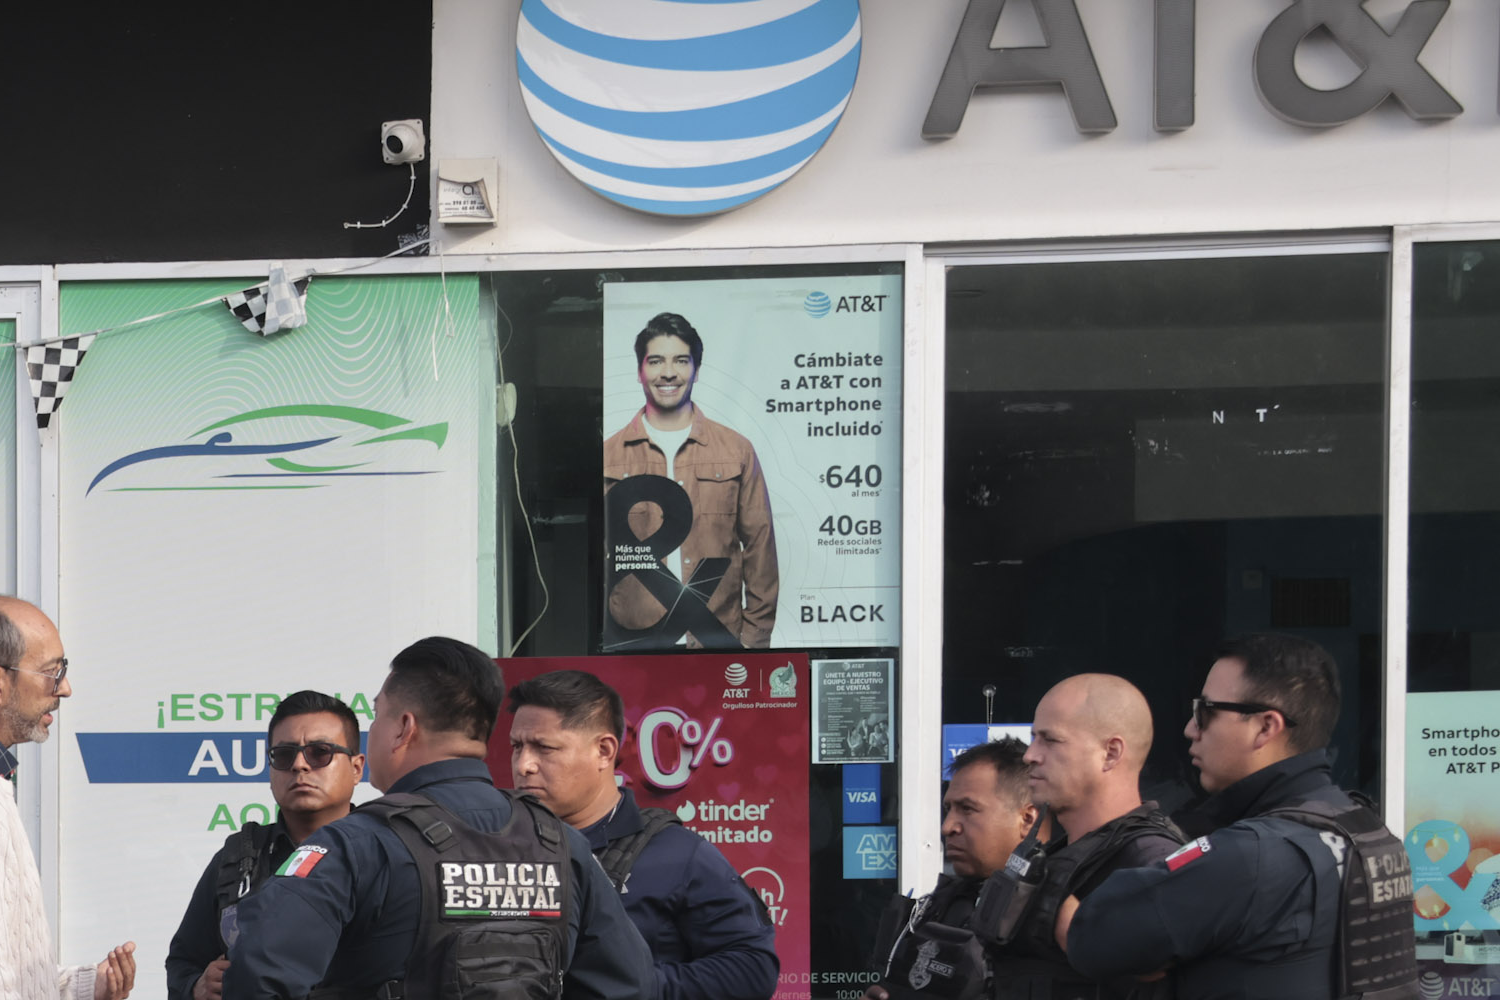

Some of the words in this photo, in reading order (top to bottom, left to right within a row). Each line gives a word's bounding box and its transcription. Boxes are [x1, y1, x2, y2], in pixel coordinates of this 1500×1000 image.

[835, 295, 887, 313] AT&T
[793, 352, 884, 369] Cámbiate
[780, 378, 791, 390] a
[795, 375, 844, 390] AT&T
[849, 376, 883, 389] con
[765, 398, 882, 415] Smartphone
[807, 422, 883, 437] incluido
[819, 464, 883, 489] $640
[851, 489, 860, 498] al
[615, 545, 633, 553] Más
[634, 546, 651, 554] que
[817, 538, 844, 546] Redes
[846, 537, 883, 546] sociales
[615, 562, 660, 572] personas.
[800, 604, 885, 623] BLACK
[722, 688, 750, 699] AT&T
[156, 692, 376, 729] ¡ESTRA
[722, 701, 754, 710] Orgulloso
[755, 700, 798, 709] Patrocinador
[187, 739, 267, 776] AU
[1428, 747, 1447, 757] en
[1451, 744, 1497, 757] todos
[1445, 762, 1487, 774] AT&T
[846, 791, 877, 803] VISA
[698, 800, 770, 821] tinder
[856, 834, 897, 854] AM
[862, 851, 897, 871] EX
[441, 863, 561, 886] POLICIA
[444, 886, 561, 909] ESTATAL
[801, 973, 818, 984] DE
[821, 971, 881, 984] SERVICIO
[1448, 977, 1494, 997] AT&T
